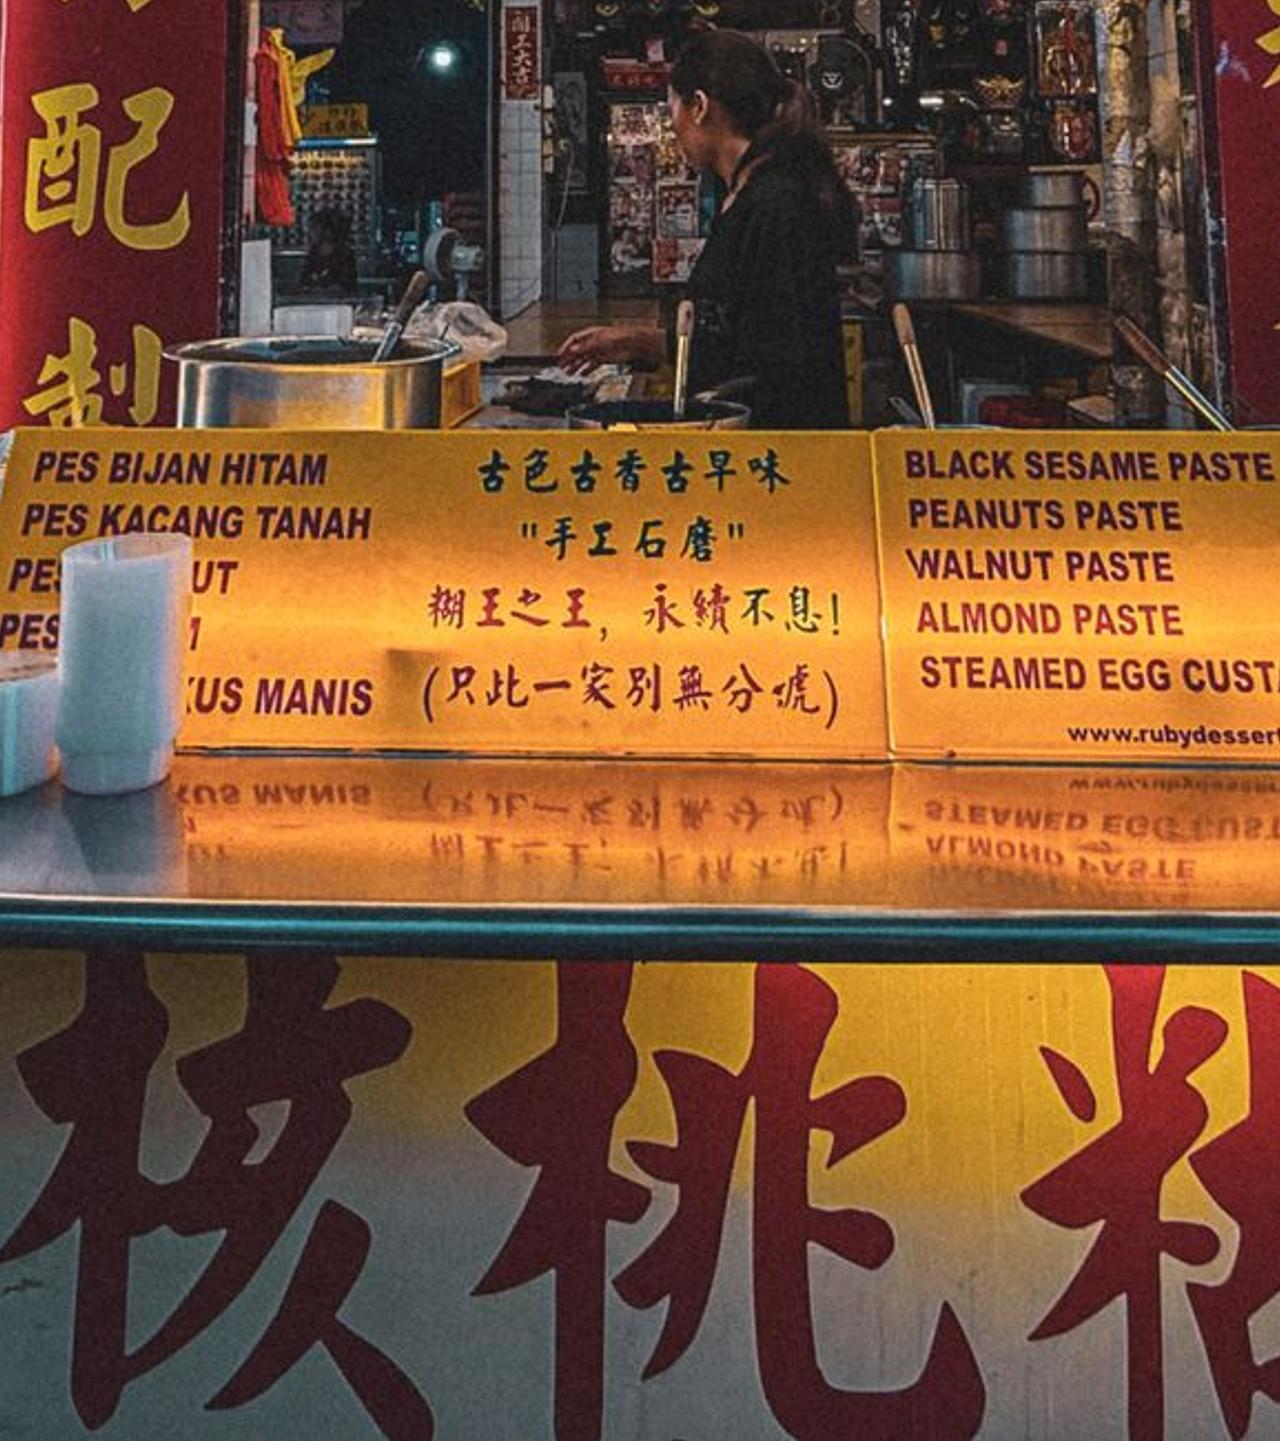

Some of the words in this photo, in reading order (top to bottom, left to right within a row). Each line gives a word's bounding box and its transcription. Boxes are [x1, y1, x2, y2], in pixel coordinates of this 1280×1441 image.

[33, 450, 100, 483] PES
[107, 451, 210, 485] BIJAN
[219, 453, 328, 486] HITAM
[477, 447, 791, 495] 古色古香古早味
[905, 449, 1015, 480] BLACK
[1025, 450, 1160, 482] SESAME
[1168, 451, 1276, 482] PASTE
[22, 503, 89, 537] PES
[98, 504, 244, 539] KACANG
[256, 506, 372, 540] TANAH
[909, 499, 1066, 530] PEANUTS
[1075, 500, 1184, 532] PASTE
[905, 548, 1054, 581] WALNUT
[1066, 550, 1175, 583] PASTE
[916, 601, 1062, 635] ALMOND
[1073, 603, 1185, 637] PASTE
[920, 655, 1087, 691] STEAMED
[1099, 658, 1172, 693] EGG
[253, 677, 374, 717] MANIS
